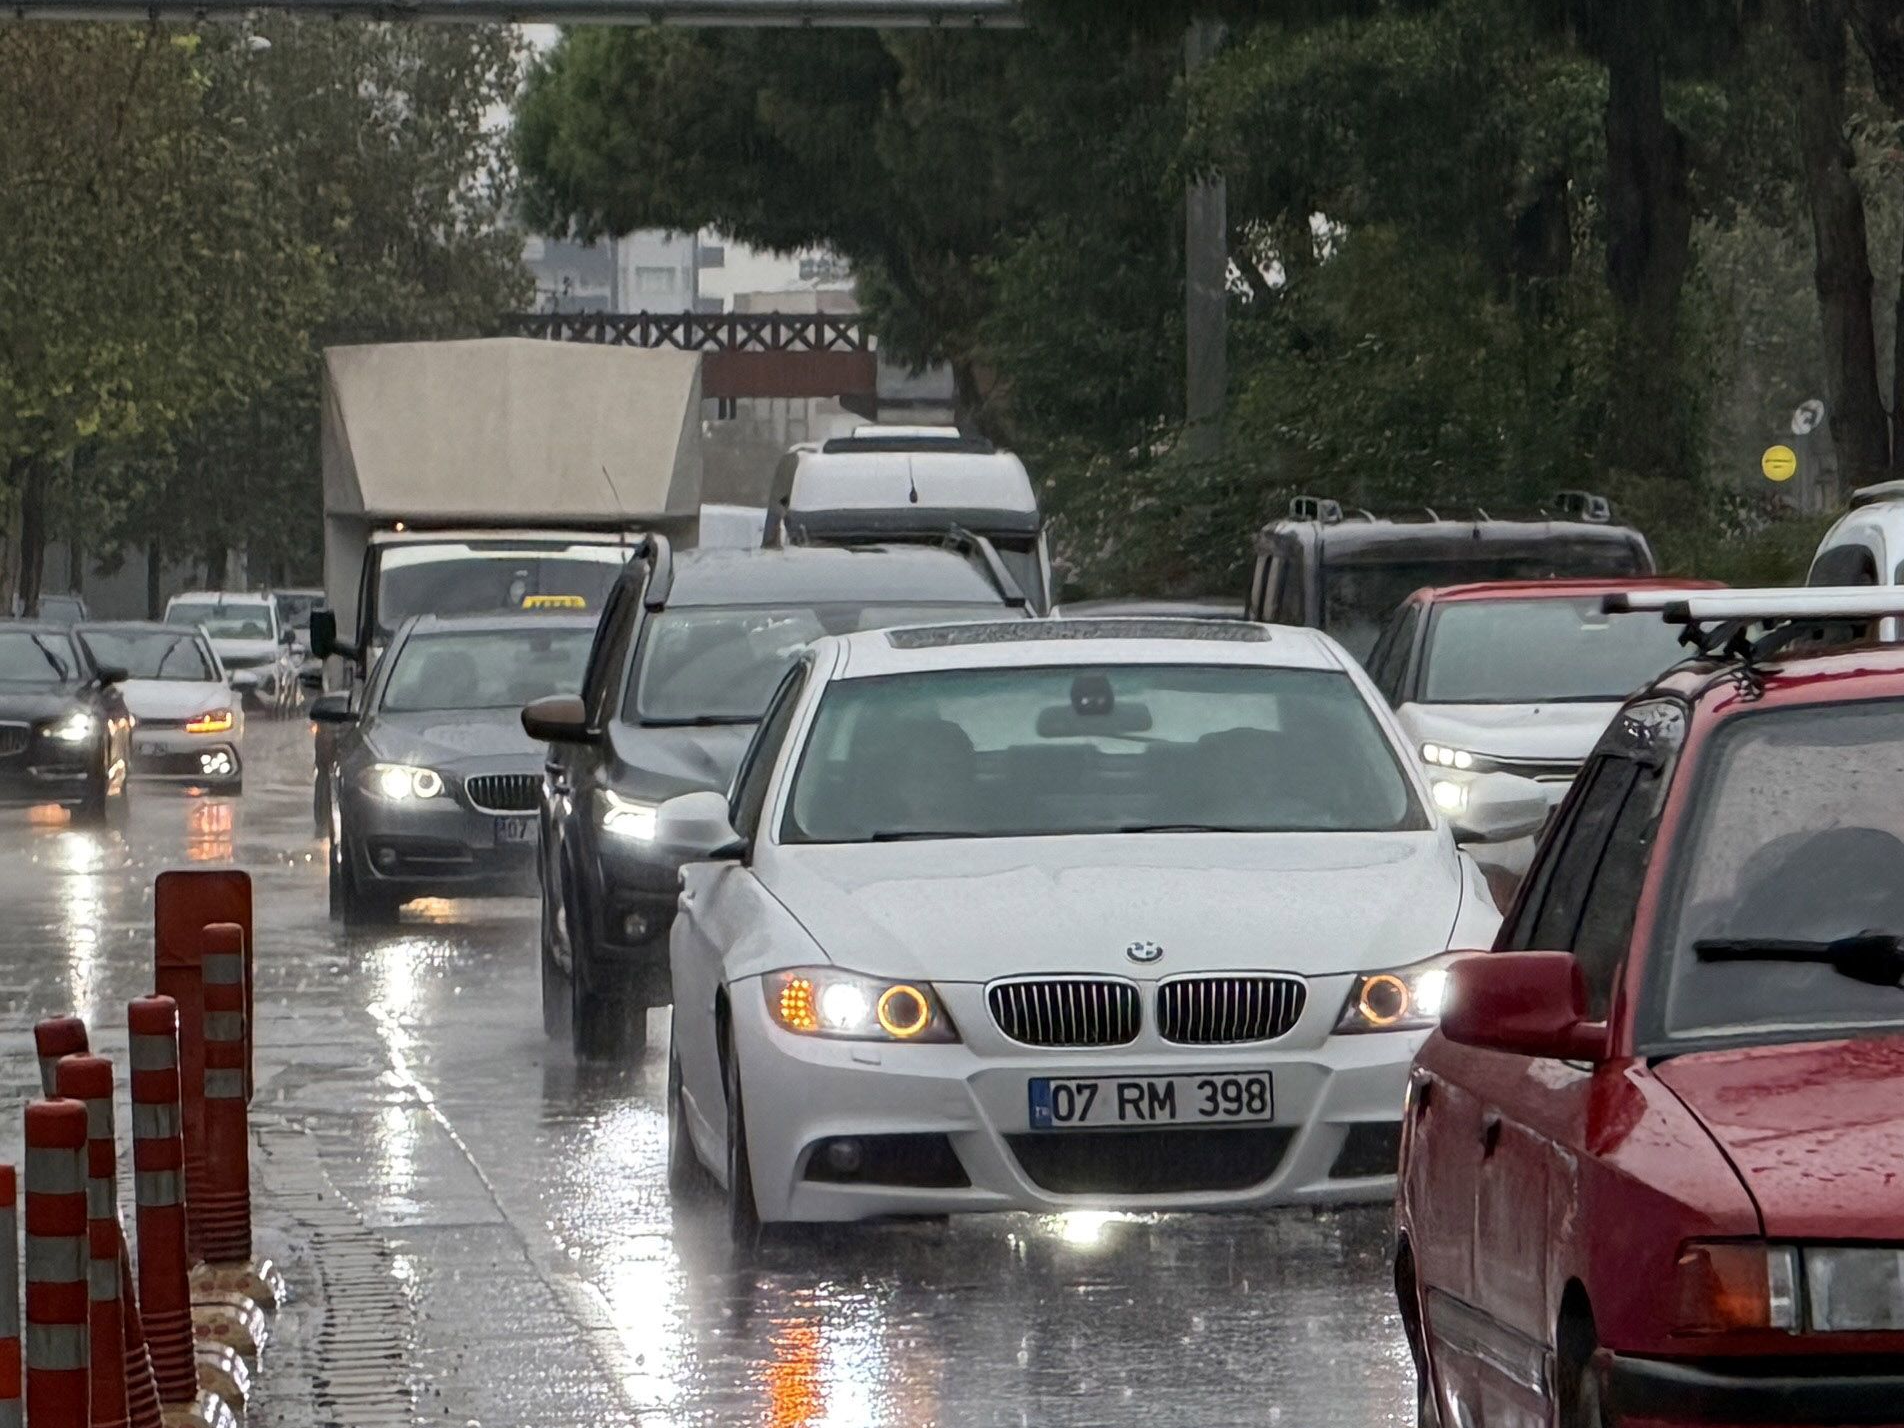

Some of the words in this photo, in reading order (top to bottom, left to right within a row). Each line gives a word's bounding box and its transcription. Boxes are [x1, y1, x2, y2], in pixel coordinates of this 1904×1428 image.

[1052, 1083, 1099, 1122] 07
[1117, 1080, 1177, 1121] RM
[1197, 1077, 1268, 1117] 398
